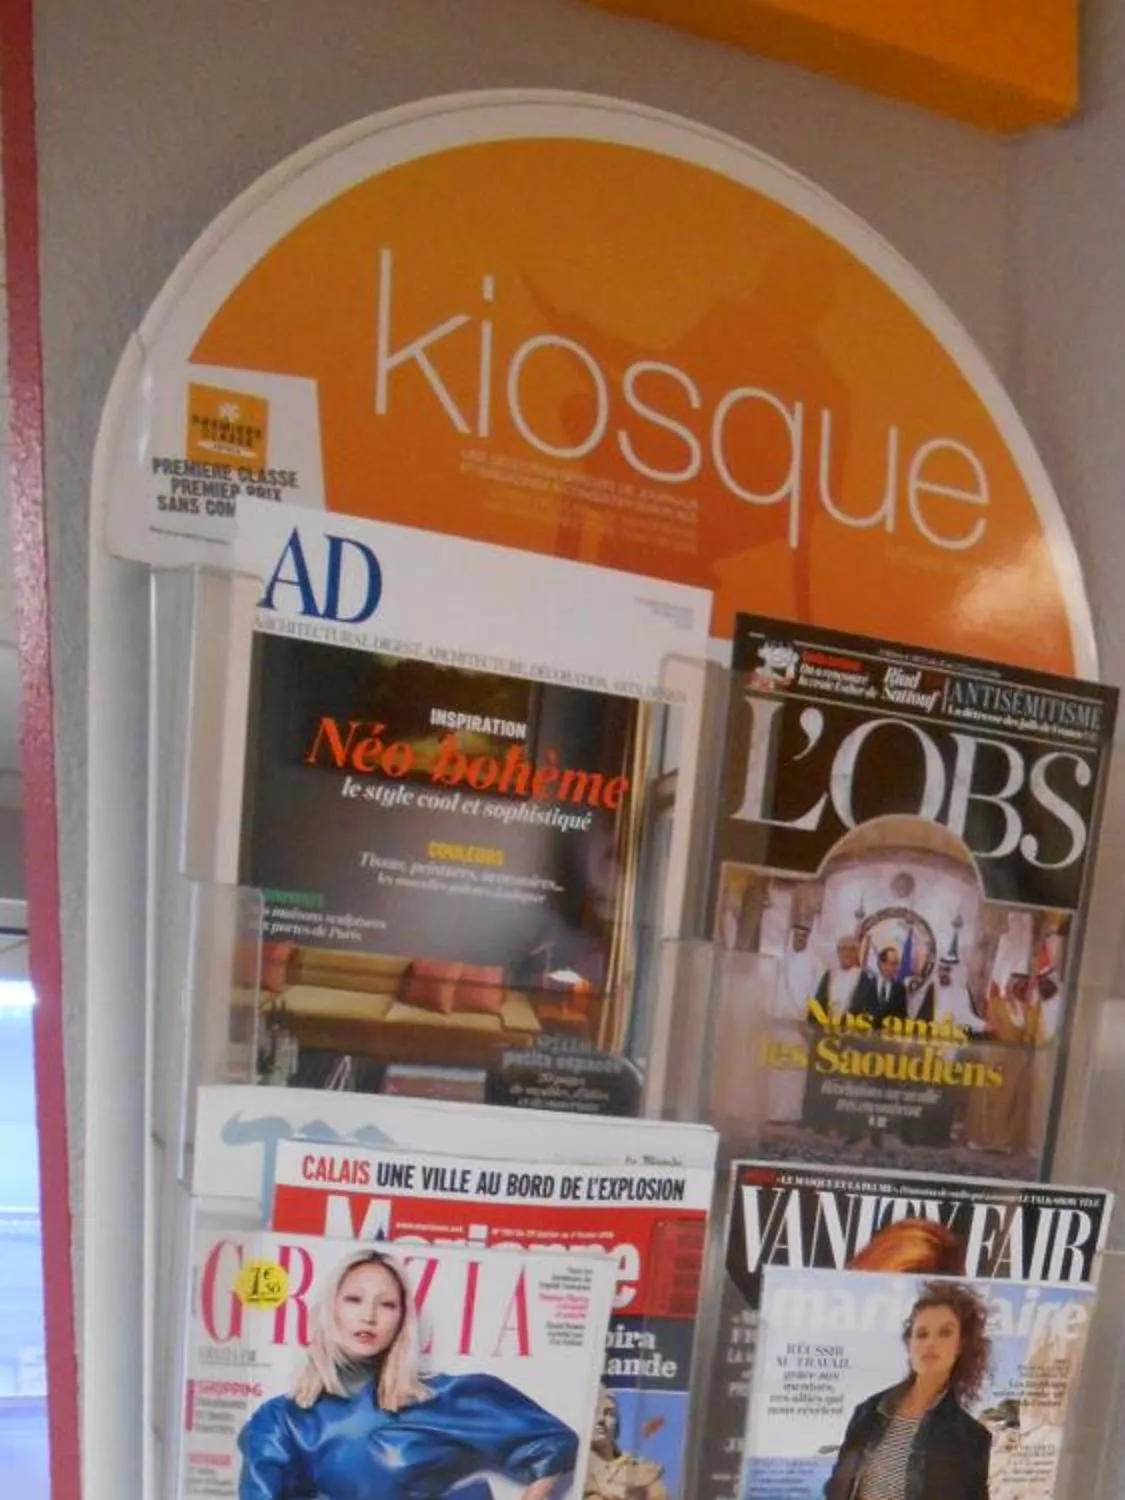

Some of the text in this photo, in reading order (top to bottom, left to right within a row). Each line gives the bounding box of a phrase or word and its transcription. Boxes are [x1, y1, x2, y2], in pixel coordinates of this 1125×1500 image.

[375, 248, 990, 550] kiosque
[237, 466, 299, 489] CLASSE
[157, 495, 201, 515] SANS
[256, 527, 384, 625] AD
[253, 615, 369, 650] ARCHITECTURAL
[430, 707, 528, 739] INSPIRATION
[305, 716, 629, 810] Néo bohème
[730, 696, 1093, 870] L'OBS
[342, 776, 593, 833] le style cool et sophistiqué
[807, 995, 971, 1047] Nos amis
[814, 1038, 1005, 1089] Saoudiens
[302, 1154, 685, 1203] CALAIS UNE VILLE AU BORD DE L'EXPLOSION
[966, 1203, 1095, 1284] FAIR
[202, 1239, 532, 1359] GRZIA
